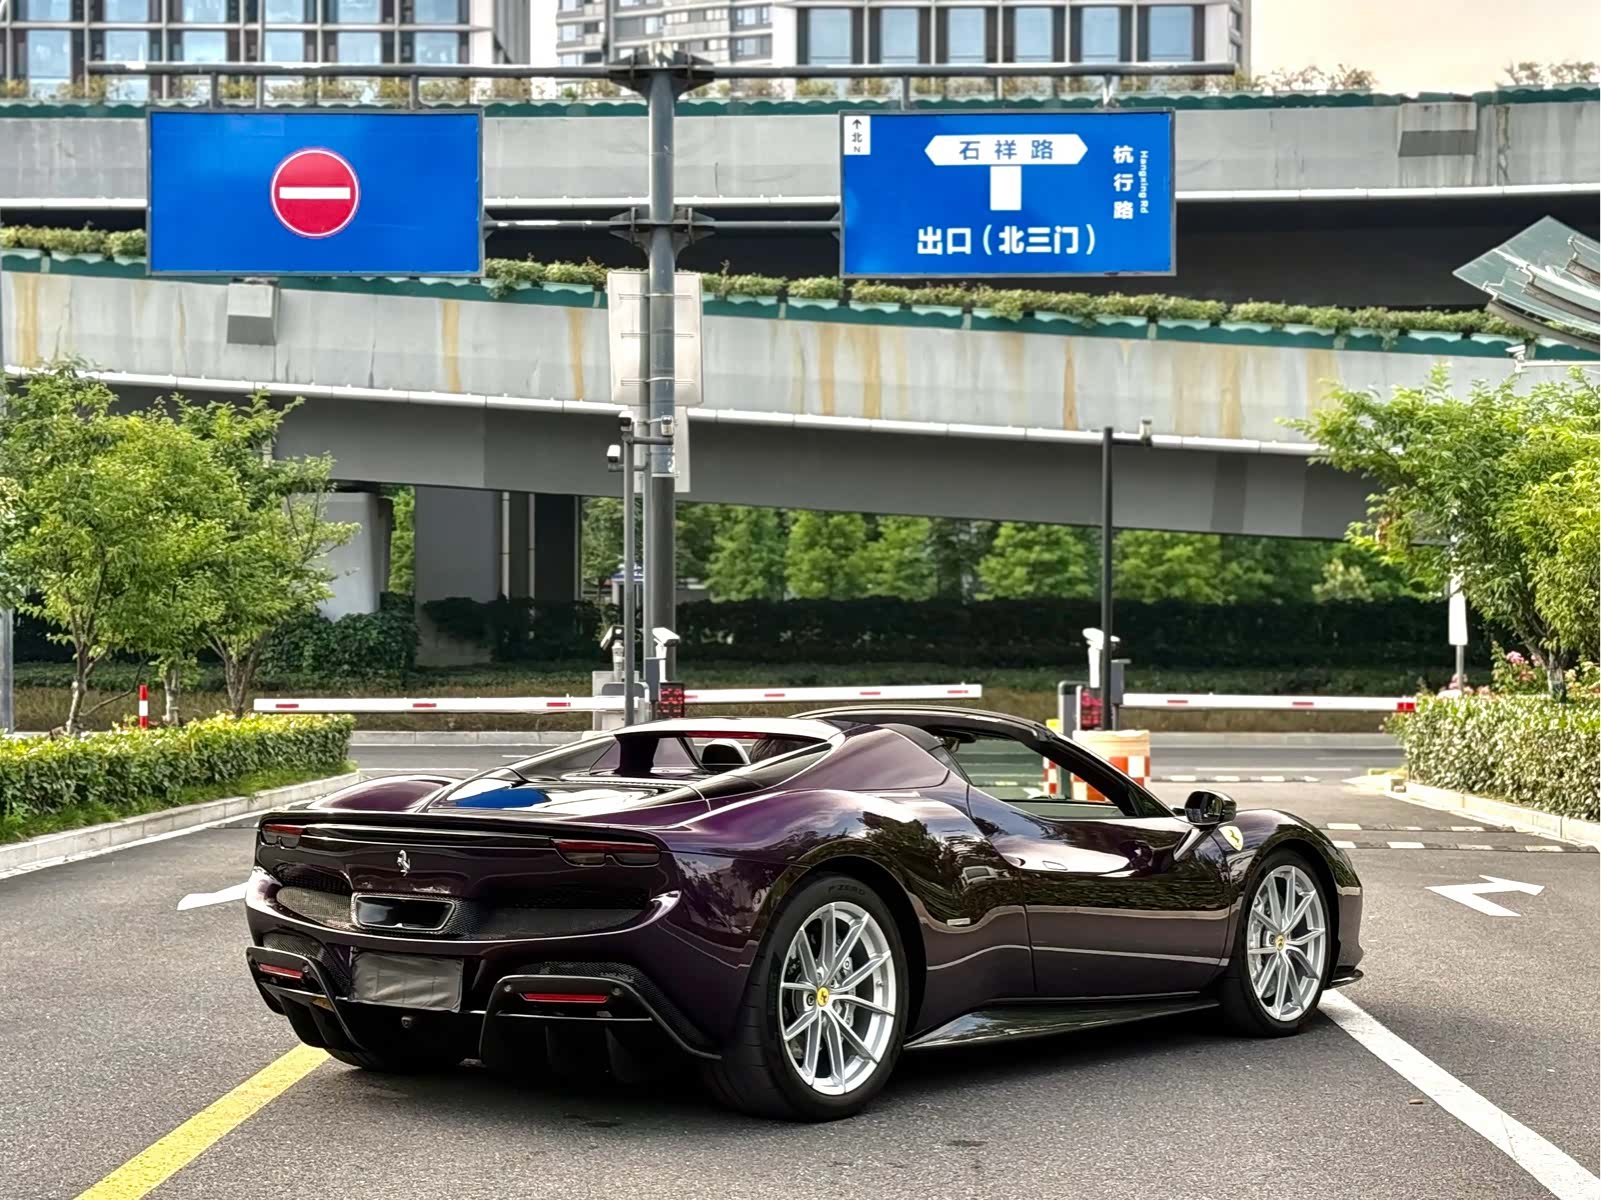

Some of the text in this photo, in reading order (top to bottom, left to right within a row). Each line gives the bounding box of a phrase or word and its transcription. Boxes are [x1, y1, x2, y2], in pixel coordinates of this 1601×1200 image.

[852, 132, 863, 144] 北
[959, 139, 1054, 161] 石祥路
[1113, 145, 1134, 220] 杭行路
[1138, 150, 1149, 214] Hangxing Rd
[917, 224, 1096, 256] 出口（北三门）
